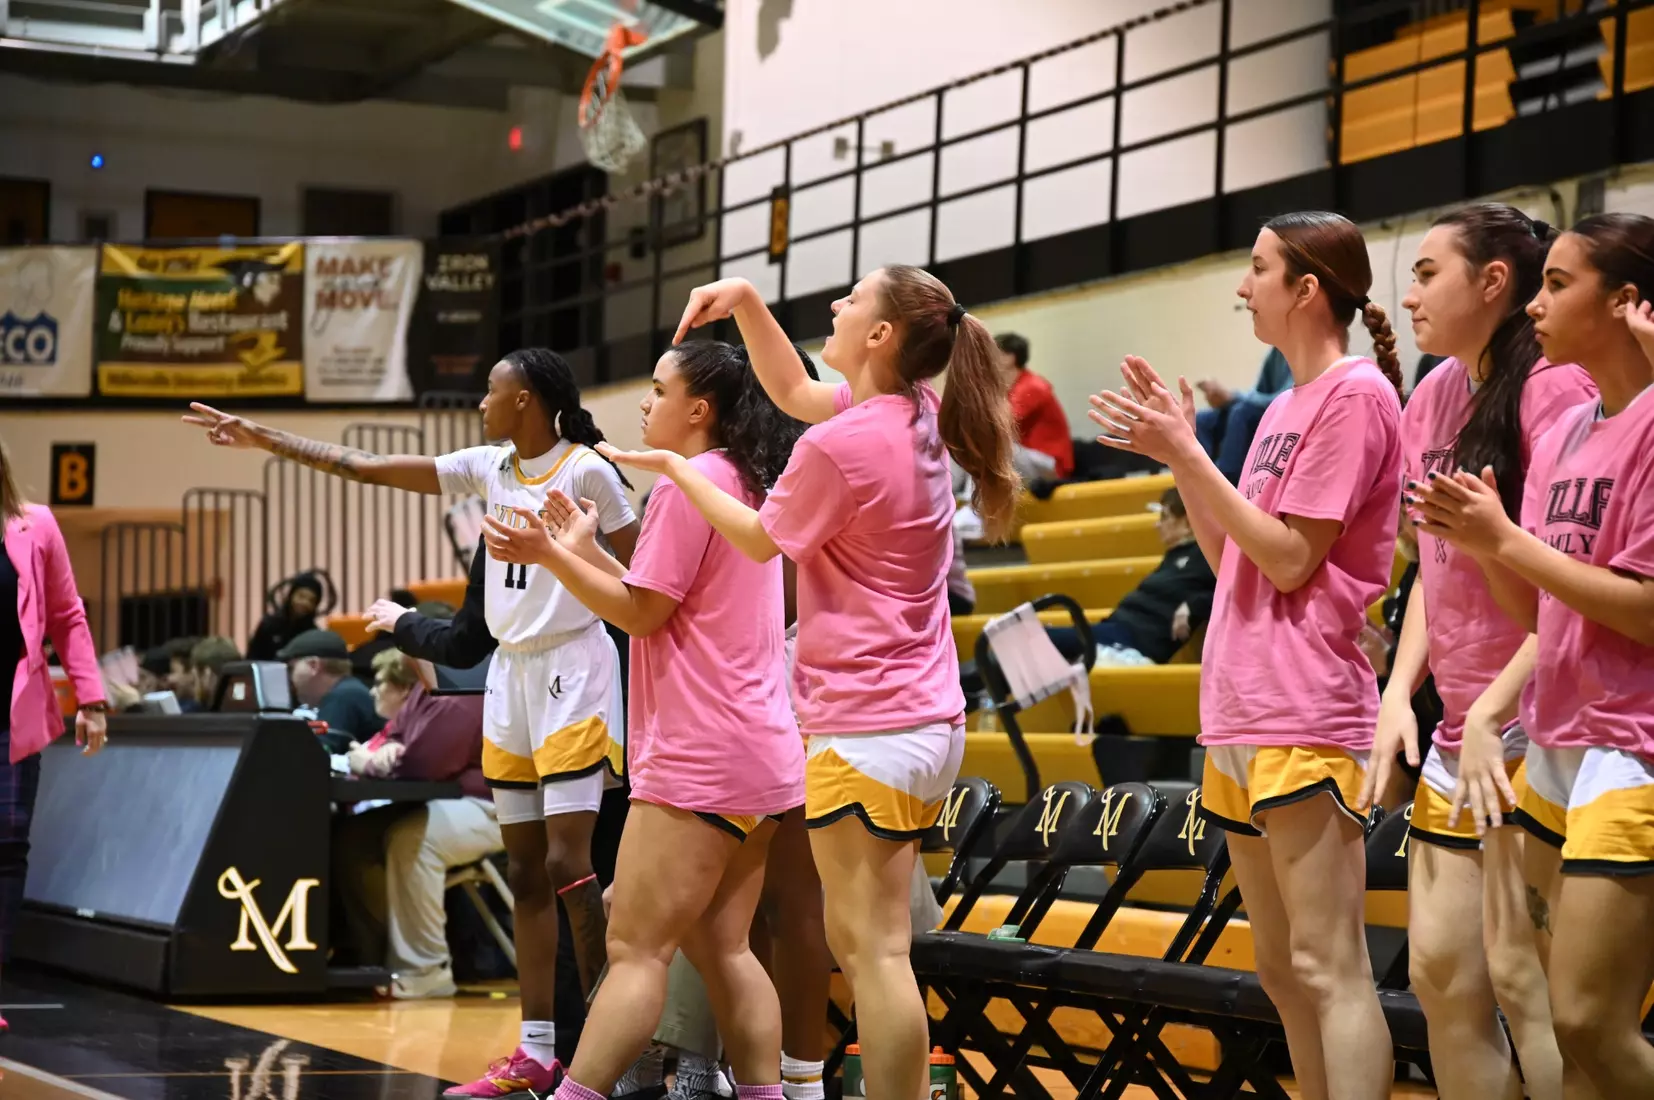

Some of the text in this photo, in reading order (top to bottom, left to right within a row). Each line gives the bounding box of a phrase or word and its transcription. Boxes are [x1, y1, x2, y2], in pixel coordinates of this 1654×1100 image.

[316, 256, 393, 275] MAKE
[426, 274, 495, 291] VALLEY
[188, 310, 288, 333] Restaurant
[172, 333, 225, 356] Support
[59, 453, 87, 500] B
[1034, 785, 1071, 847] M
[1093, 787, 1132, 851] M
[218, 866, 320, 974] M
